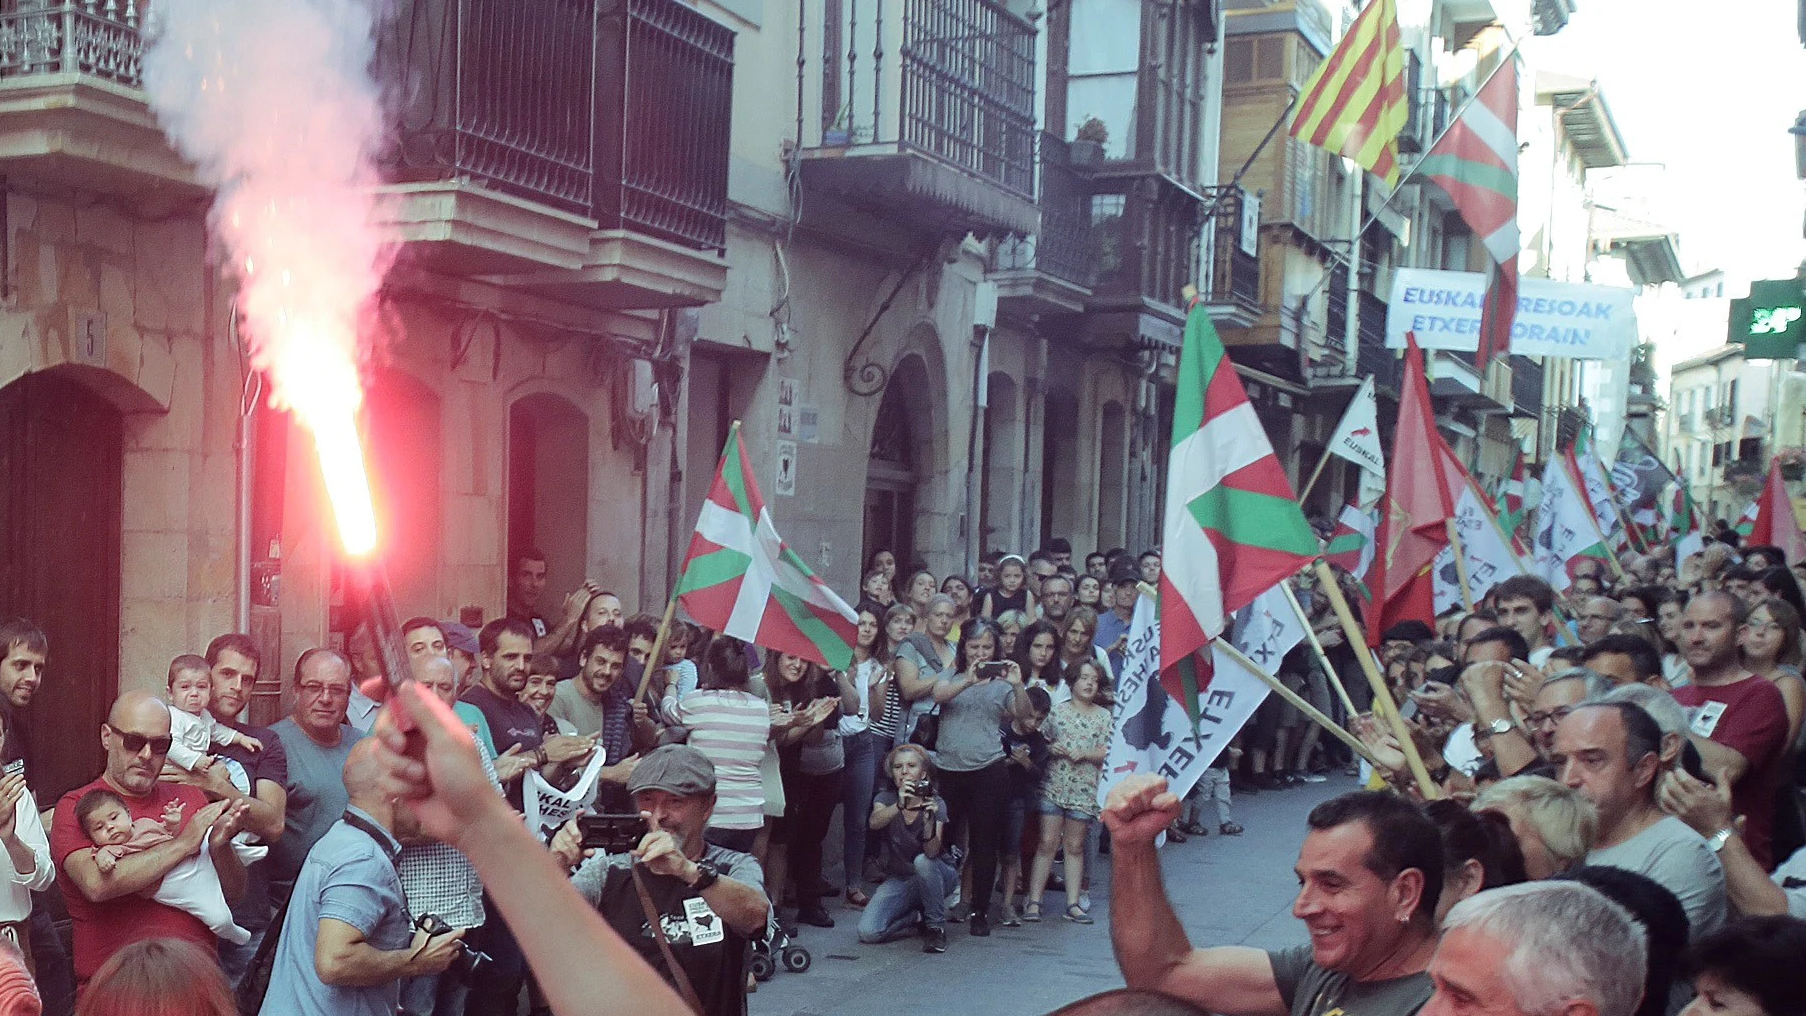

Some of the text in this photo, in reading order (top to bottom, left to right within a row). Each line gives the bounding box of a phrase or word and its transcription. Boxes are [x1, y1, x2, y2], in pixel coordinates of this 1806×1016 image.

[1516, 295, 1613, 321] RESOAK
[86, 318, 94, 357] 5
[1411, 314, 1481, 335] ETXER
